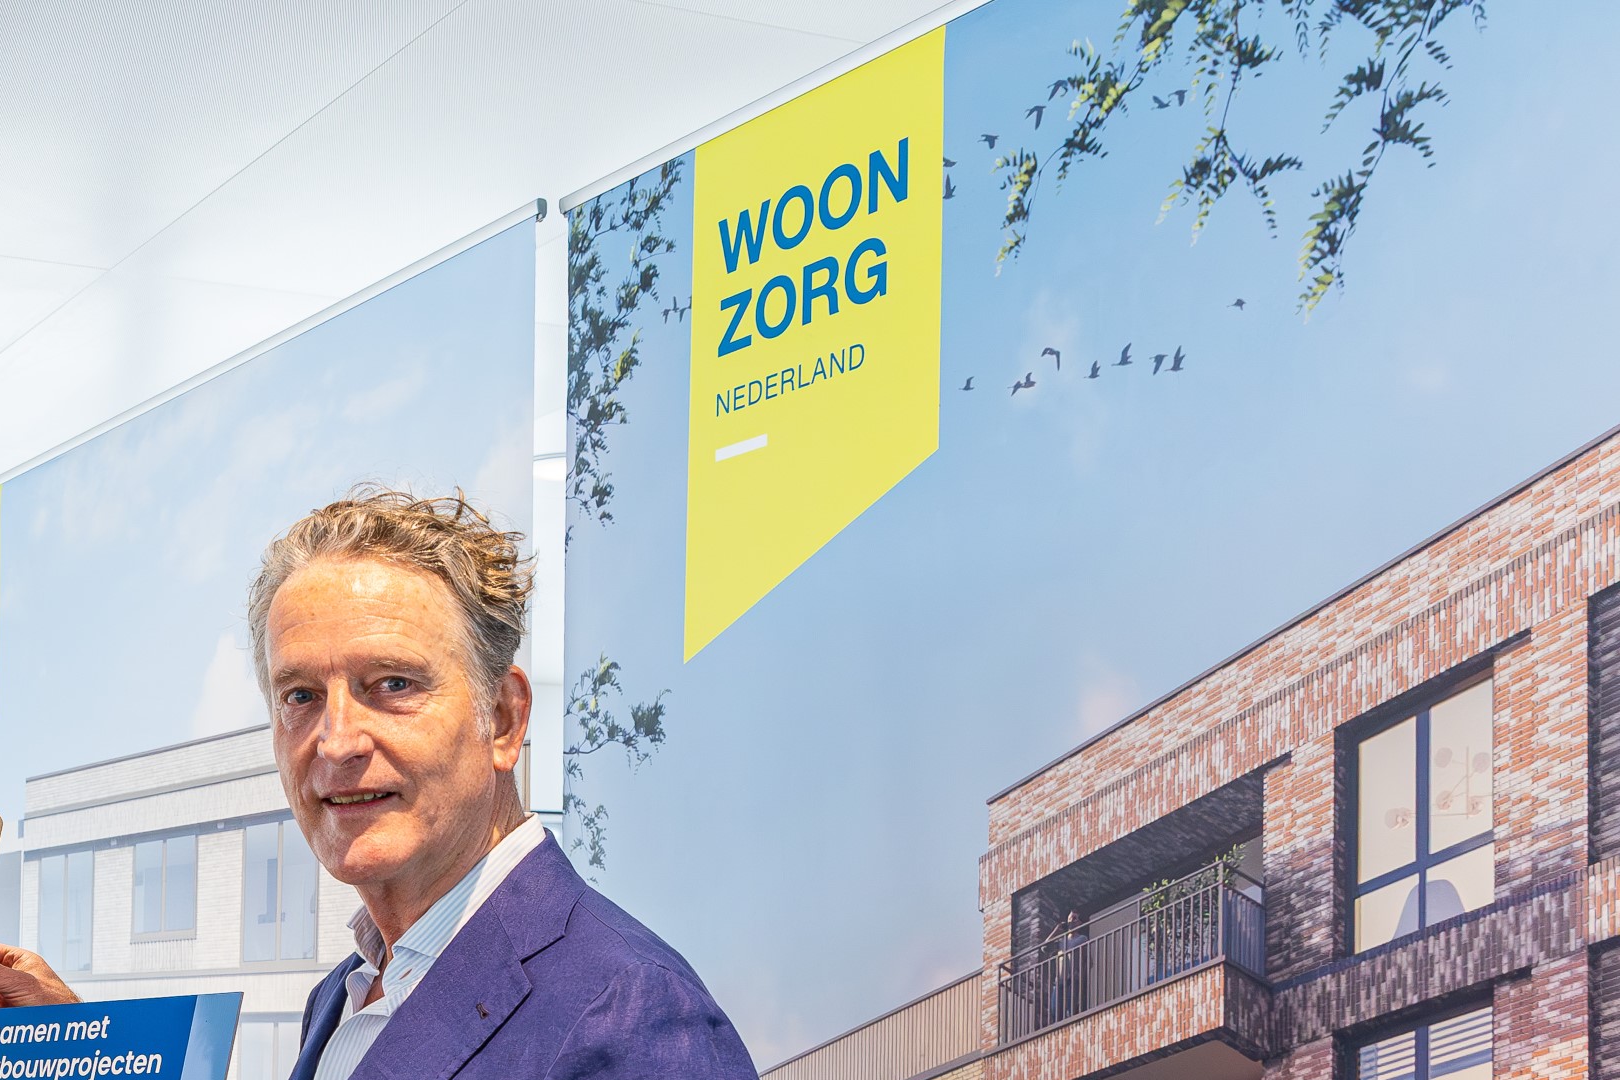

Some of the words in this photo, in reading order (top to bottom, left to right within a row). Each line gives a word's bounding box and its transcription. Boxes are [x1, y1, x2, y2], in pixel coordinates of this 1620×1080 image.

[718, 136, 909, 274] WOON
[717, 237, 887, 358] ZORG
[716, 343, 865, 417] NEDERLAND
[64, 1015, 110, 1040] met
